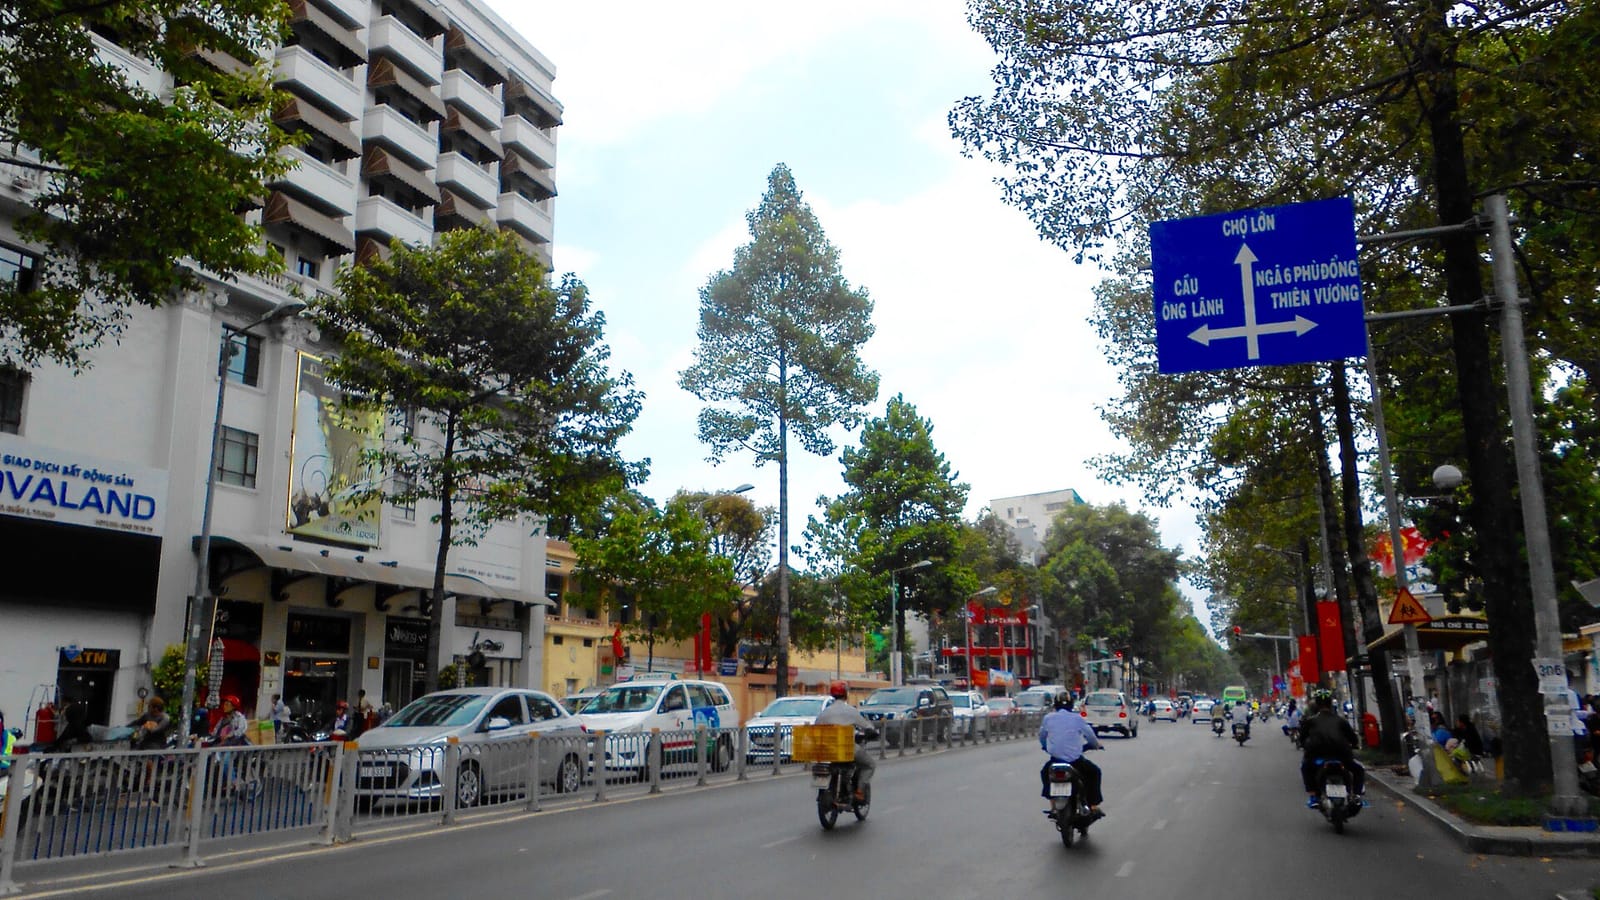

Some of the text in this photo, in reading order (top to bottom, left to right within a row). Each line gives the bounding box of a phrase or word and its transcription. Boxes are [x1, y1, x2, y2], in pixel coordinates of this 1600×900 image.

[1222, 211, 1276, 239] CHỢ LỚN
[1255, 254, 1358, 287] NGÃ 6 PHÙ ĐỔNG
[1162, 296, 1225, 321] ÔNG LÃNH
[1270, 282, 1360, 309] THIÊN VƯƠNG
[3, 454, 135, 487] GIAO DỊCH BẤT ĐỘNG SẢN
[0, 470, 156, 521] VALAND
[70, 651, 108, 665] ATM
